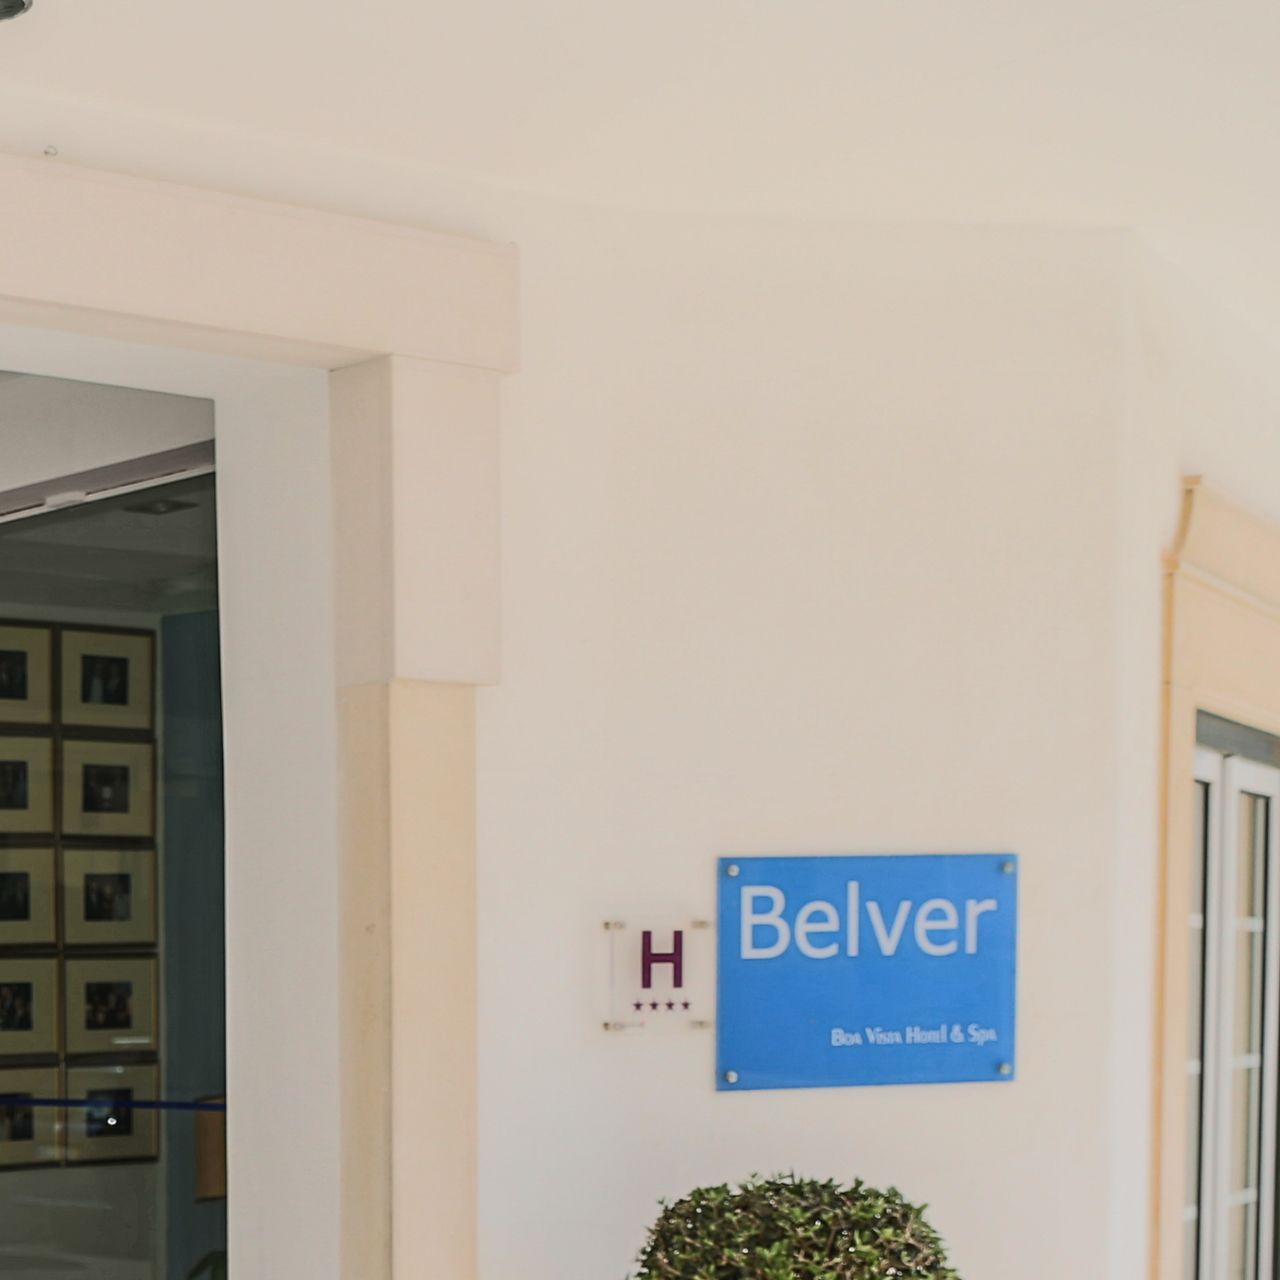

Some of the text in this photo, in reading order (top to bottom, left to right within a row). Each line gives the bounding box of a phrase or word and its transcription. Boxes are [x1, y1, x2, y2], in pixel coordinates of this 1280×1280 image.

[740, 881, 997, 959] Belver
[641, 930, 683, 989] H
[905, 1024, 948, 1044] Hotel
[950, 1023, 965, 1043] &
[967, 1023, 998, 1047] Spa
